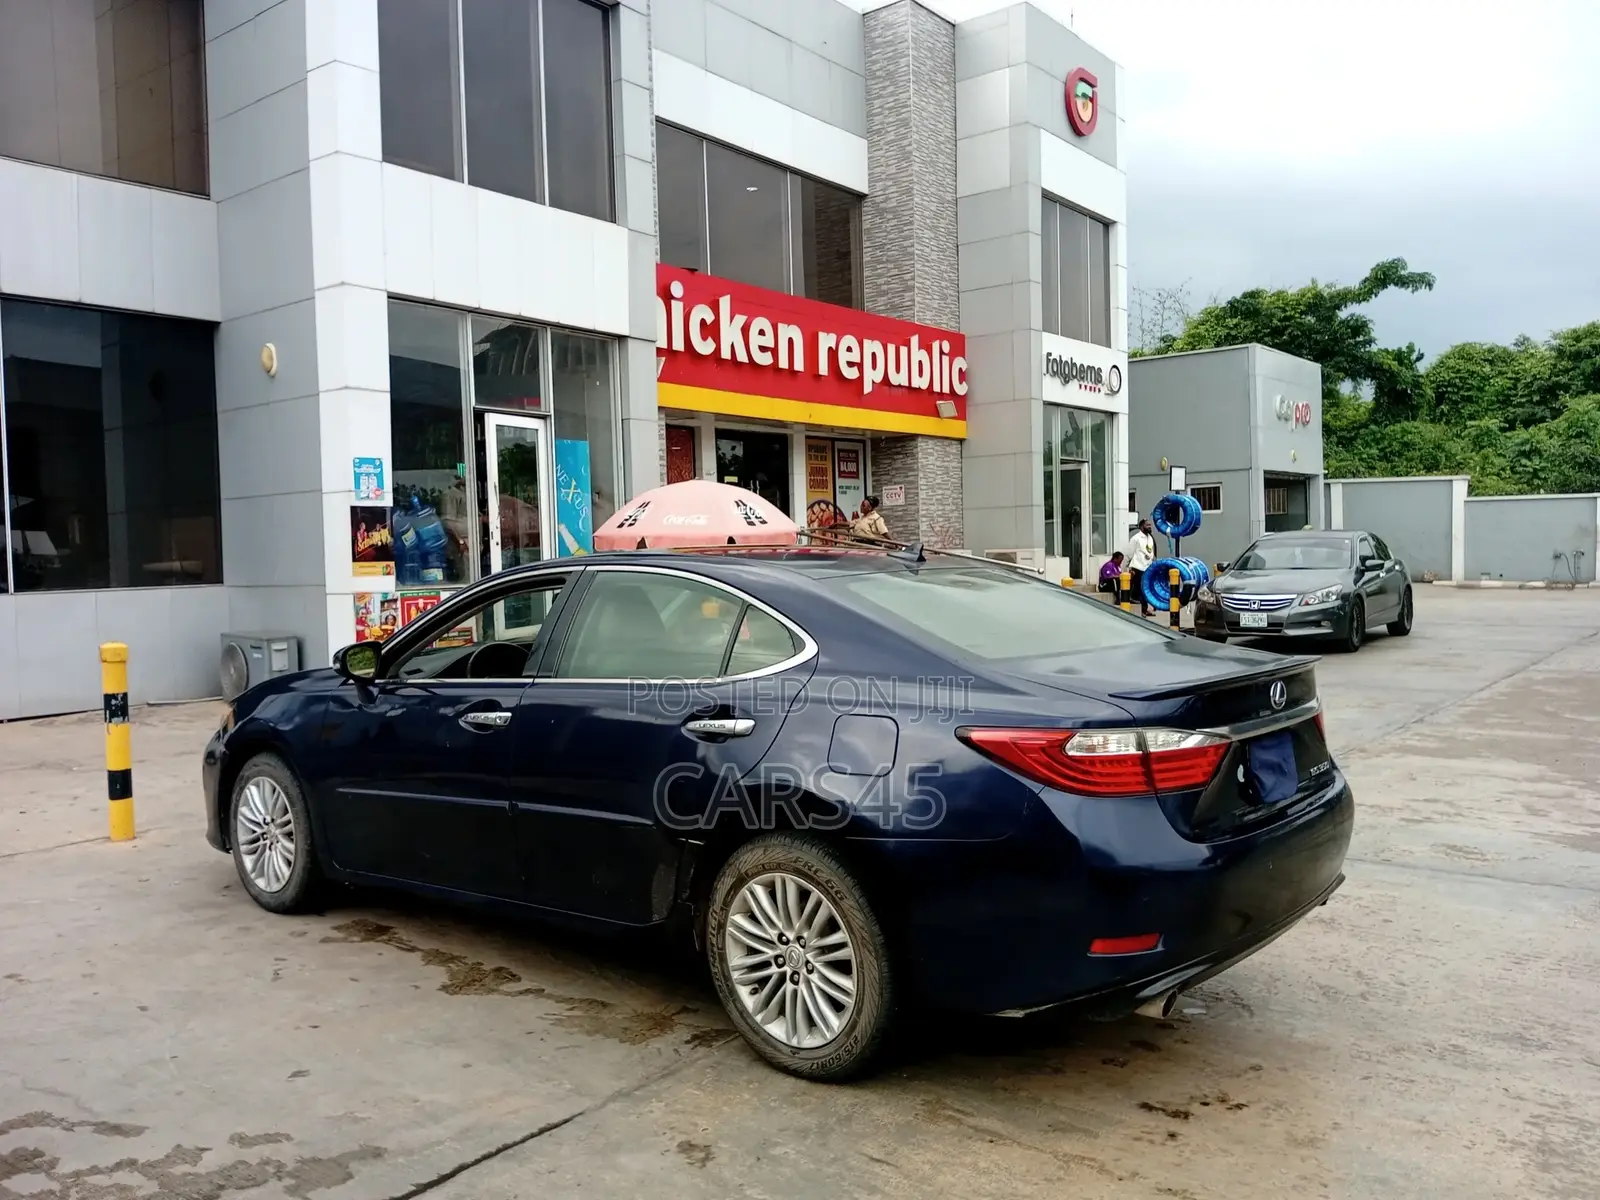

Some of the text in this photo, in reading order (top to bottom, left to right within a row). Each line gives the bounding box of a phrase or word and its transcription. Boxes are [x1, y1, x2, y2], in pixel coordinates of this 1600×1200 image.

[817, 331, 969, 397] republic
[809, 478, 828, 490] COMBO
[885, 491, 902, 499] CCTV
